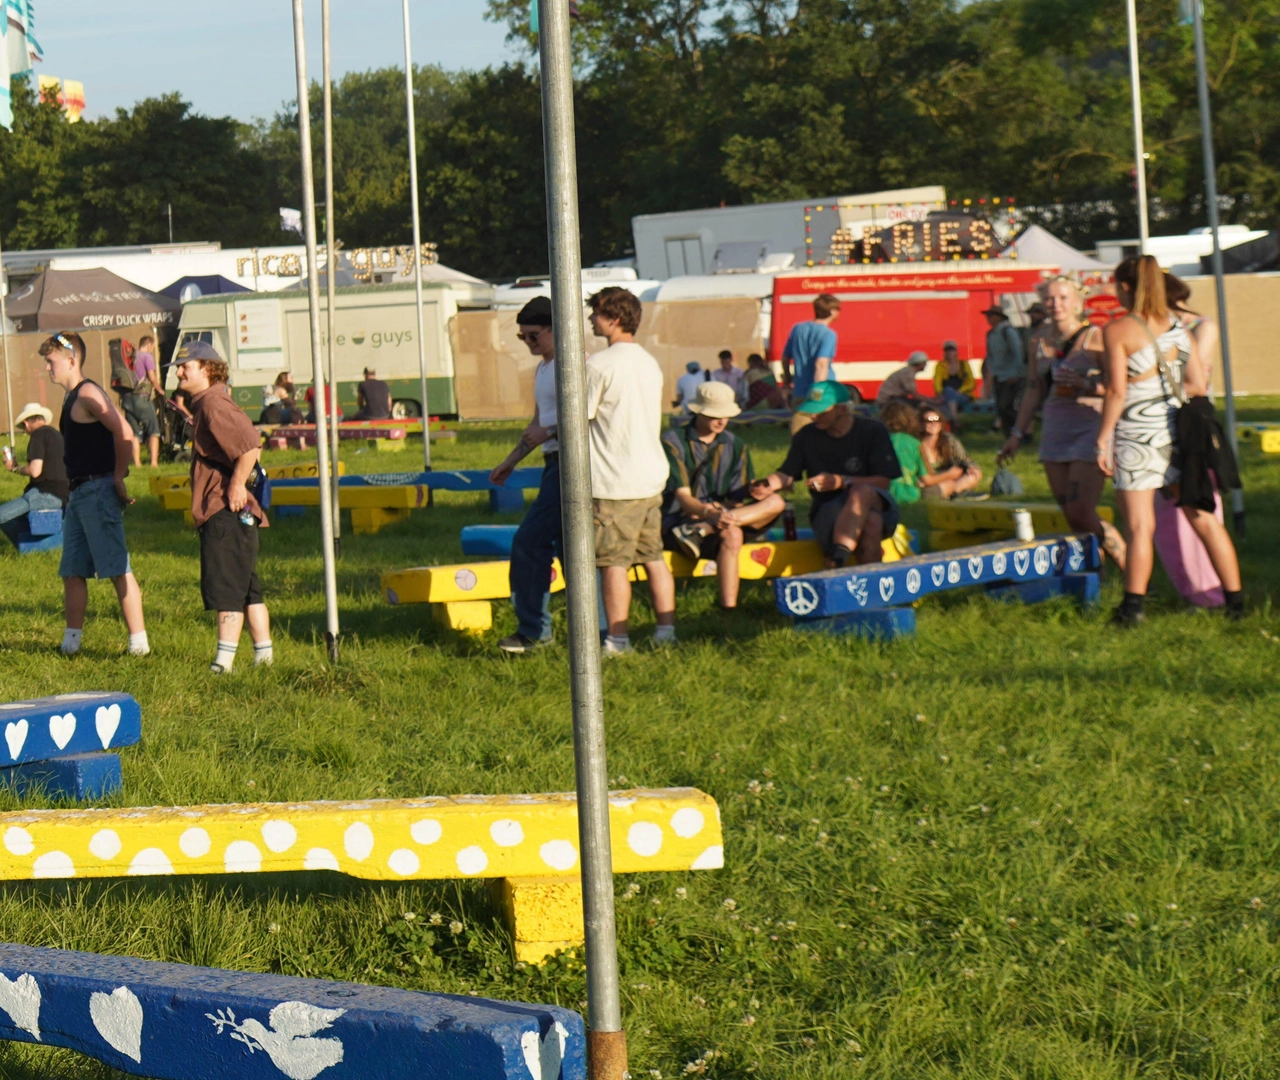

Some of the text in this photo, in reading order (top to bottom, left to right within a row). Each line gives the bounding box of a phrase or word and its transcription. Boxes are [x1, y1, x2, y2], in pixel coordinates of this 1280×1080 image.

[236, 247, 300, 277] rice
[350, 241, 439, 280] guys
[53, 293, 80, 307] THE
[82, 311, 173, 328] CRISPY DUCK WRAPS
[371, 329, 413, 349] guys
